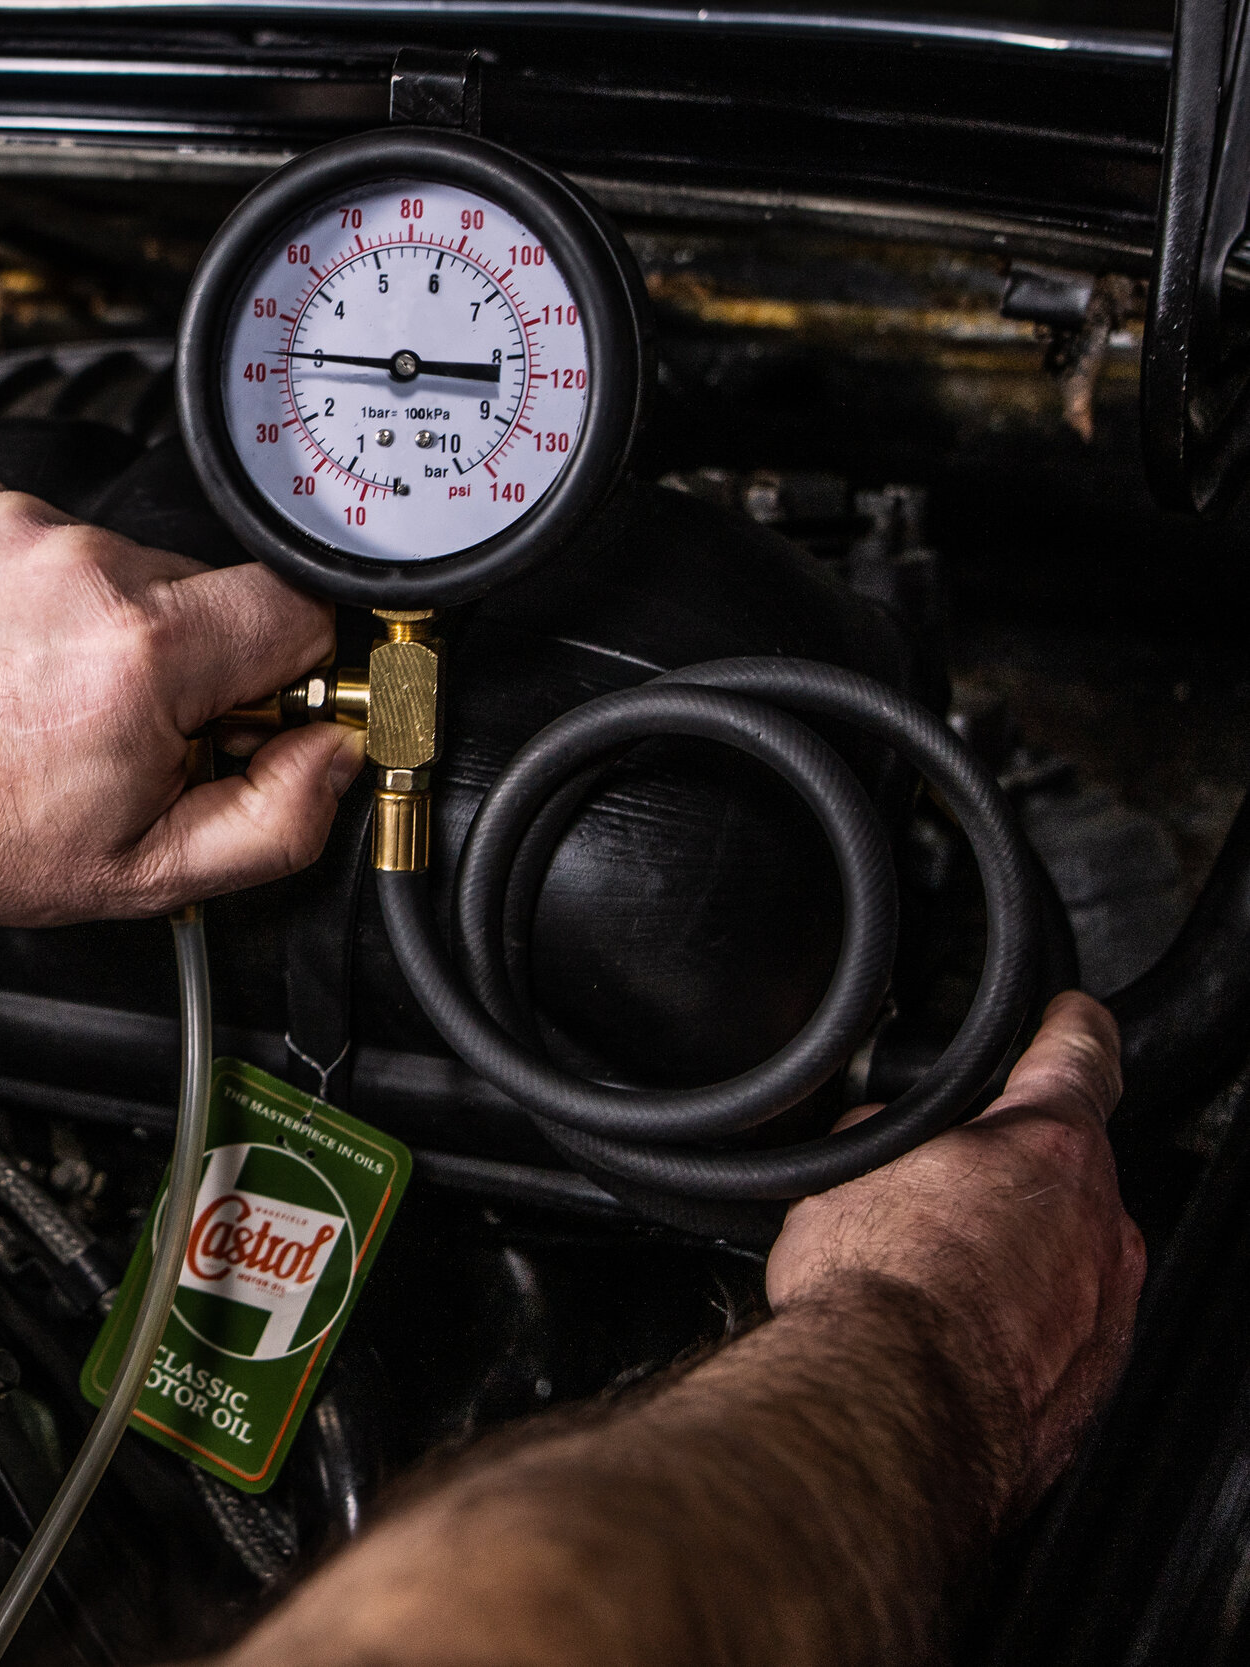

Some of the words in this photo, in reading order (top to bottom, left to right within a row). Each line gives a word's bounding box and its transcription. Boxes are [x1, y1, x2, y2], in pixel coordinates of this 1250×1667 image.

[401, 199, 423, 218] 80
[339, 209, 362, 229] 70
[461, 210, 483, 230] 90
[287, 245, 310, 264] 60
[508, 246, 544, 266] 100
[379, 274, 388, 293] 5
[429, 274, 439, 294] 6
[254, 298, 276, 318] 50
[335, 301, 345, 319] 4
[471, 303, 480, 321] 7
[541, 305, 577, 325] 110
[244, 363, 266, 382] 40
[550, 369, 586, 389] 120
[325, 398, 334, 416] 2
[404, 407, 450, 421] 100kPa
[480, 400, 490, 419] 9
[257, 424, 278, 443] 30
[534, 432, 568, 452] 130
[356, 434, 365, 453] 1
[438, 434, 461, 453] 10
[425, 465, 448, 478] bar
[293, 476, 315, 495] 20
[449, 484, 471, 499] psi
[490, 482, 524, 502] 140
[344, 507, 365, 525] 10
[224, 1086, 250, 1107] THE
[250, 1100, 338, 1151] MASTERPIECE
[337, 1143, 354, 1159] IN
[354, 1152, 384, 1175] OILS
[186, 1194, 335, 1284] Castrol
[145, 1367, 208, 1418] OTOR
[211, 1407, 253, 1444] OIL
